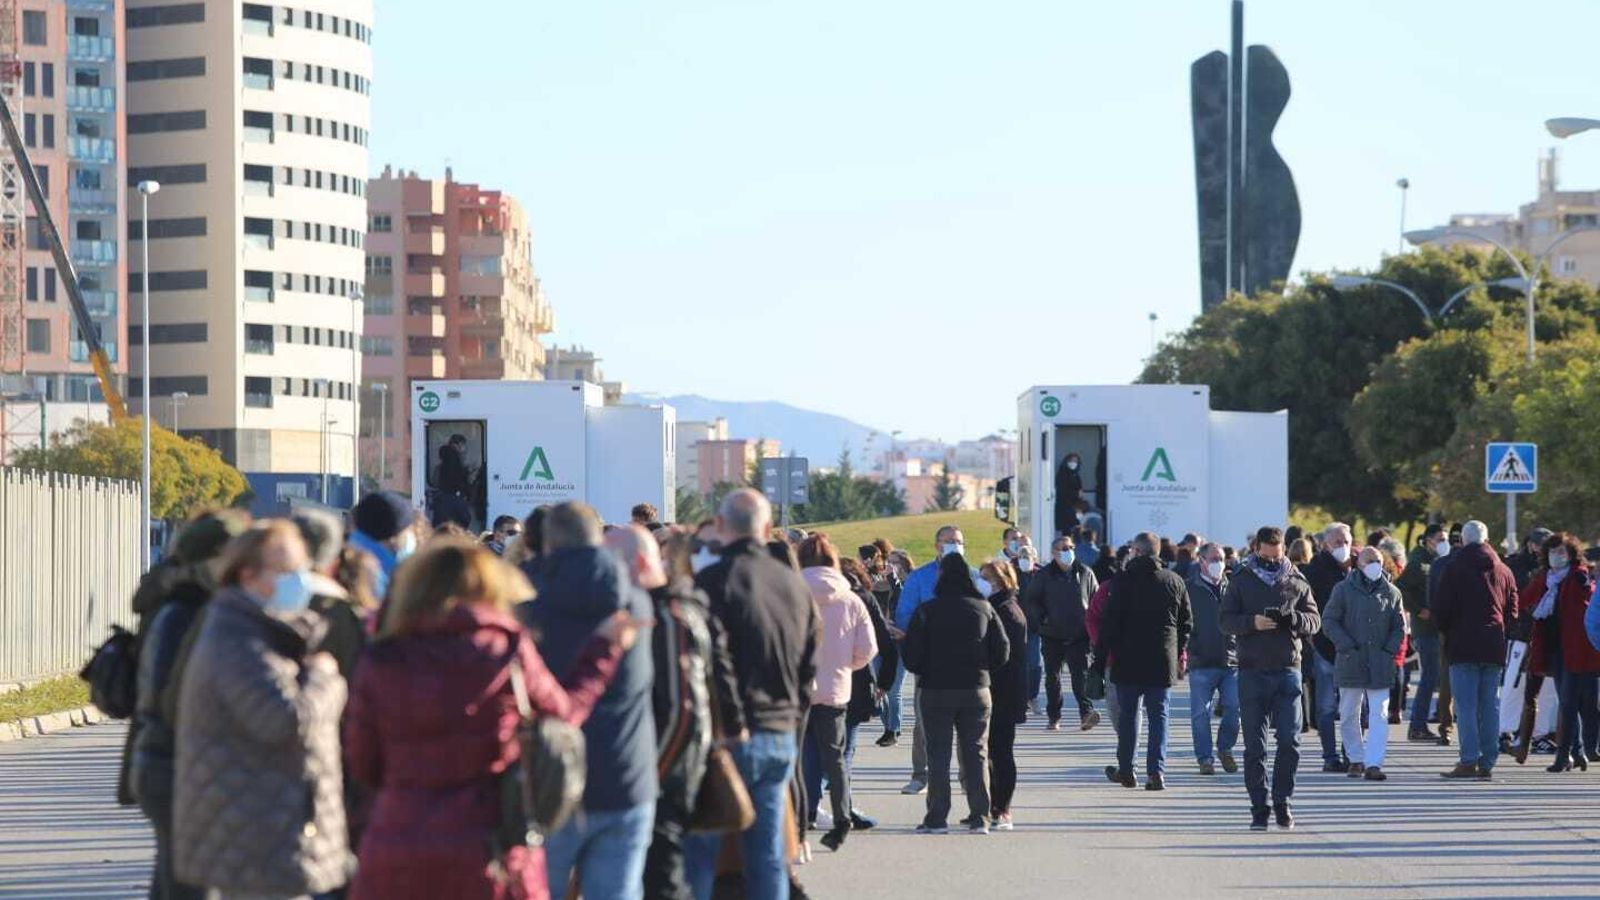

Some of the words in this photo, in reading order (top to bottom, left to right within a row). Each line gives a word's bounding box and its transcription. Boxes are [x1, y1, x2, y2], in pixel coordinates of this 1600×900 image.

[421, 396, 438, 407] C2
[1042, 401, 1058, 412] C1
[499, 482, 523, 490] Junta
[524, 482, 533, 490] de
